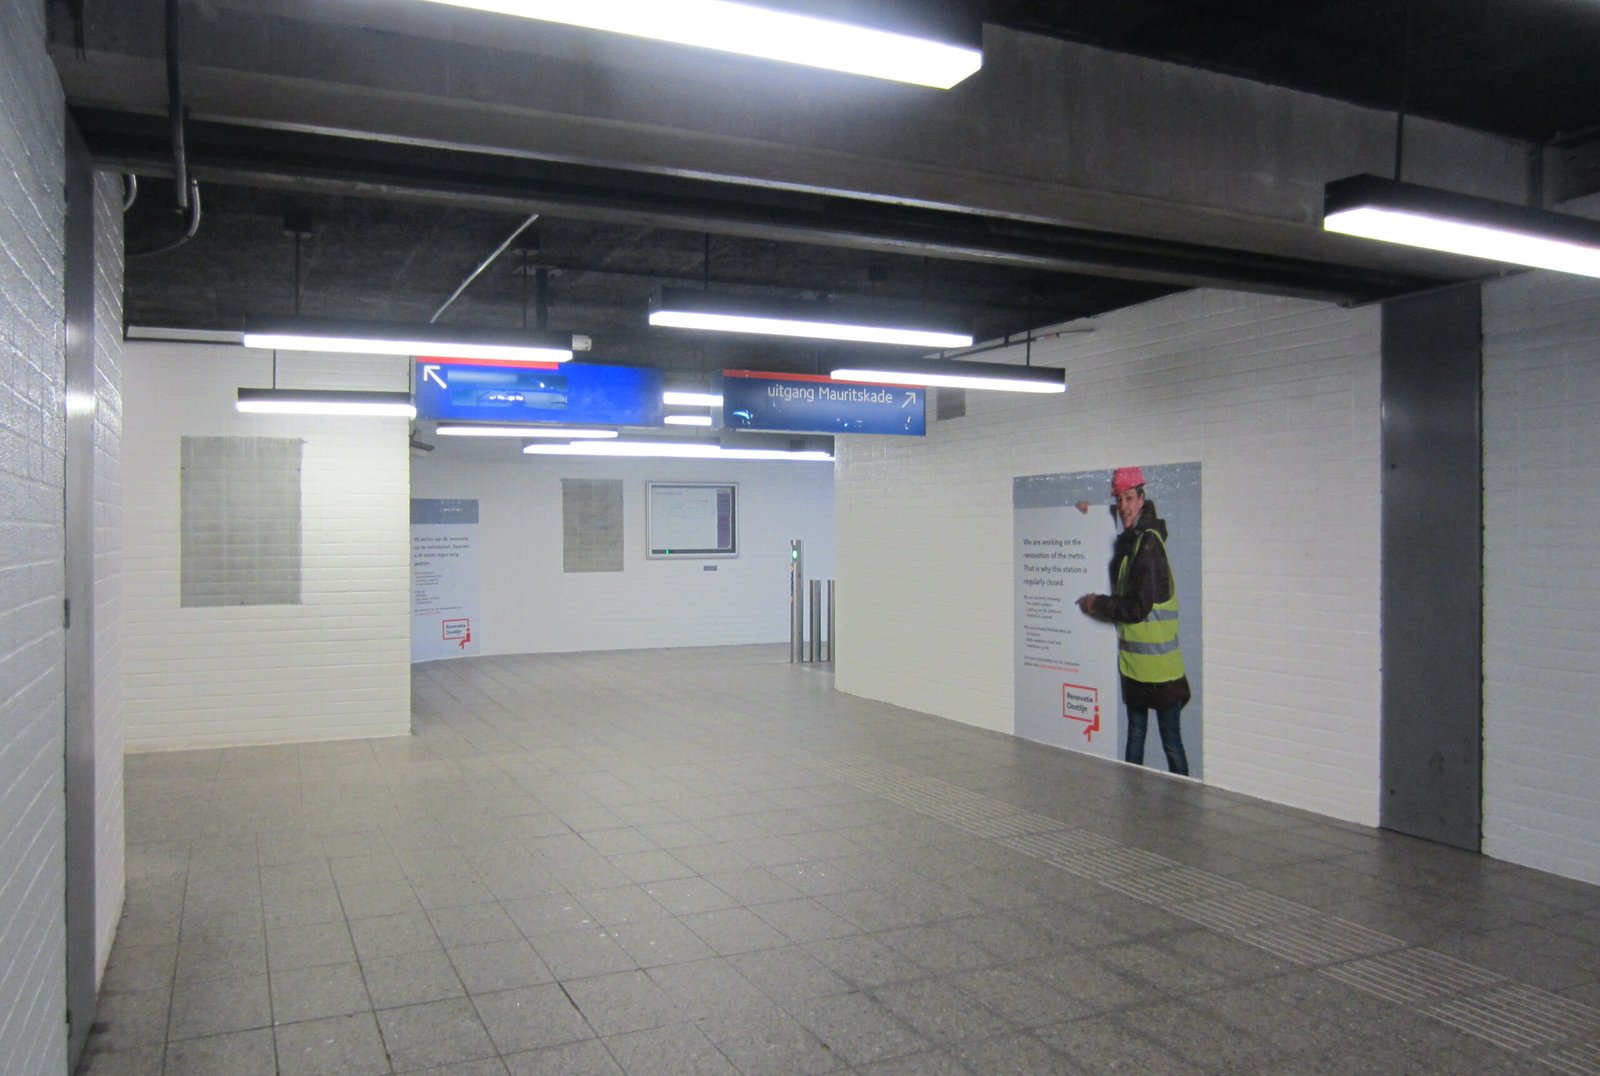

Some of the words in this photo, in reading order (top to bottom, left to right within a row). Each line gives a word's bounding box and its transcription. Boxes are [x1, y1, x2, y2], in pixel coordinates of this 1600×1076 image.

[767, 384, 814, 402] uitgang
[818, 386, 893, 404] Mauritskade
[1023, 538, 1032, 546] We
[1041, 538, 1063, 548] working
[1071, 538, 1082, 546] the
[1050, 551, 1057, 559] of
[1057, 551, 1067, 559] the
[1067, 552, 1087, 560] metro.
[1023, 563, 1034, 572] That
[1040, 564, 1051, 574] why
[1051, 565, 1062, 573] this
[1062, 566, 1082, 574] station
[1023, 578, 1045, 587] regularly
[1046, 578, 1064, 587] closed.
[1066, 691, 1094, 704] Renovatie
[1066, 702, 1088, 714] Oostlijn
